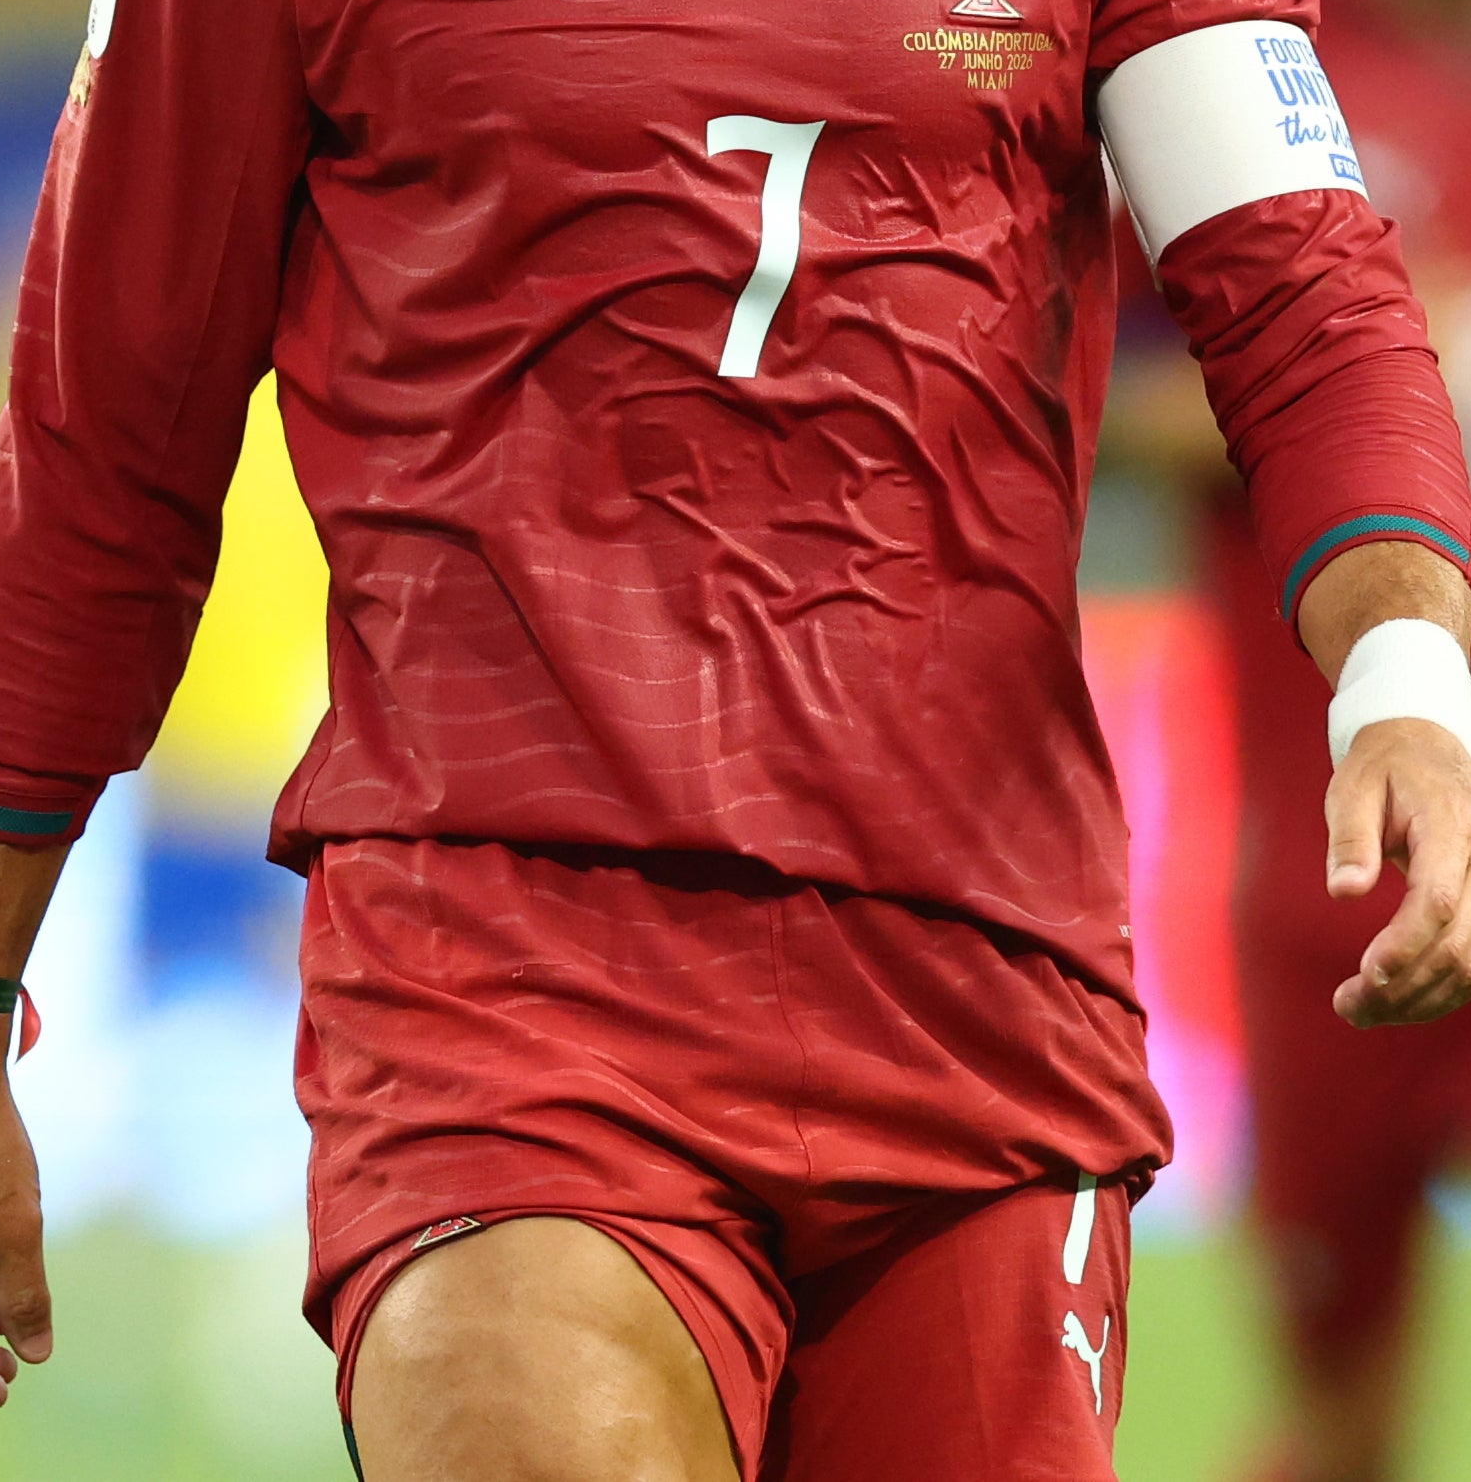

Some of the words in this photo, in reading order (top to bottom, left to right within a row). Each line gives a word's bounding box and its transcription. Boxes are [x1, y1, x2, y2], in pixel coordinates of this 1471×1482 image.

[938, 52, 956, 70] 27
[962, 53, 1003, 70] JUNHO
[1007, 53, 1033, 71] 2026
[967, 71, 1013, 90] MIAMI
[1276, 111, 1326, 146] the
[706, 114, 827, 378] 7
